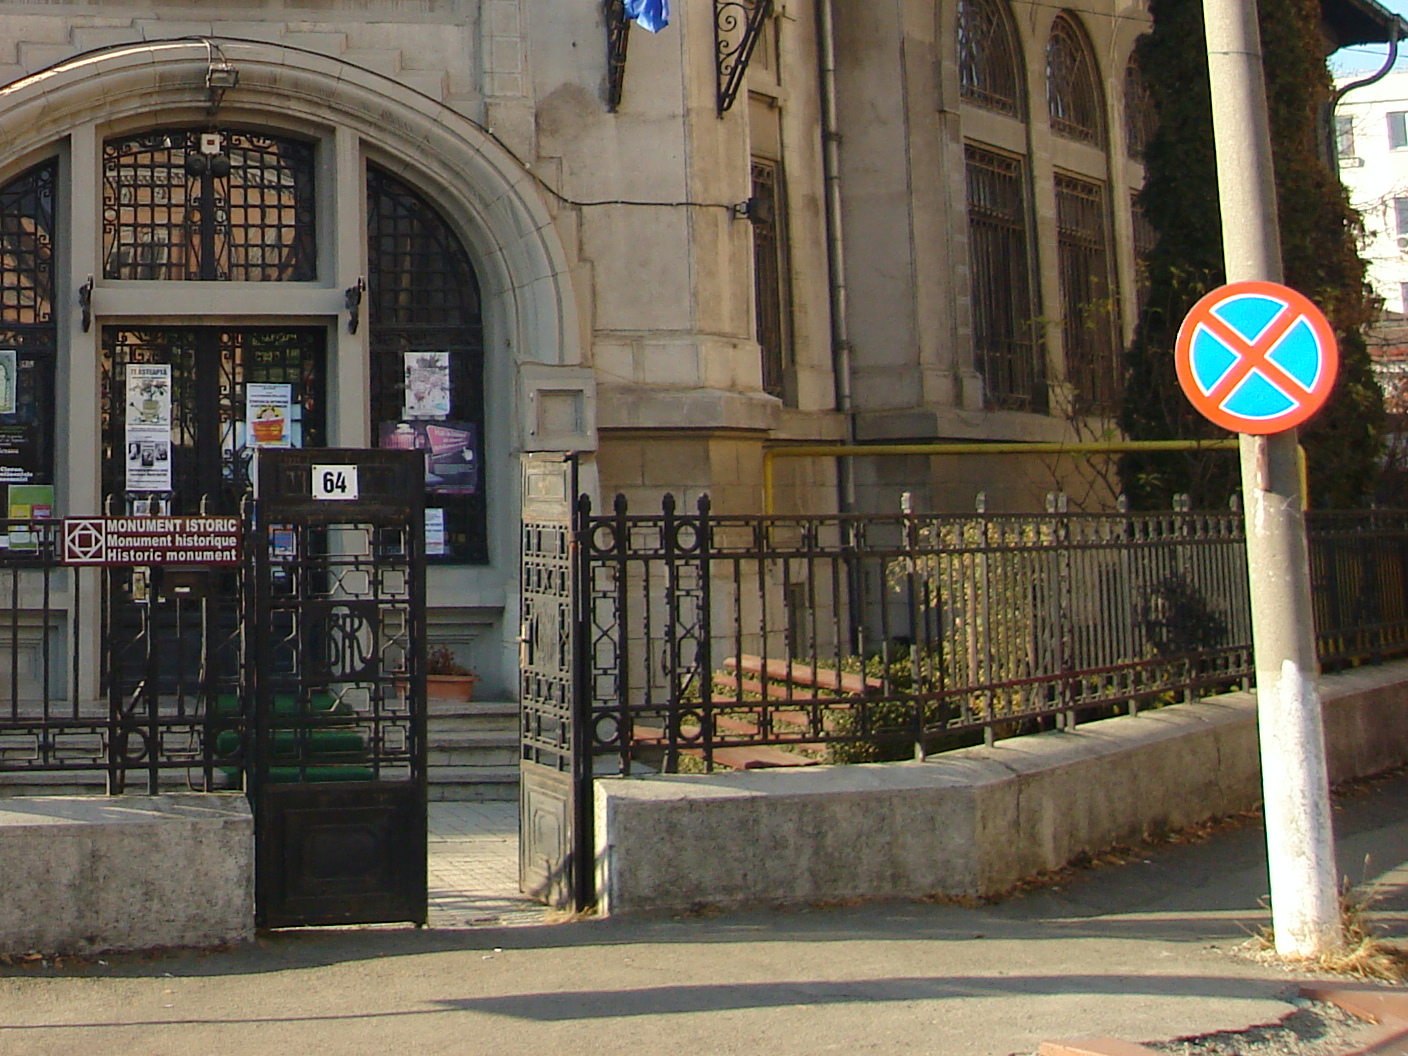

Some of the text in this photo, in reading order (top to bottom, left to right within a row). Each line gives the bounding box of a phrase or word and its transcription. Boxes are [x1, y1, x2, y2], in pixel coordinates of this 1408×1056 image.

[323, 471, 347, 494] 64
[107, 519, 237, 532] MONUMENT ISTORIC
[107, 534, 237, 549] Monument historique
[107, 548, 237, 561] Historic monument
